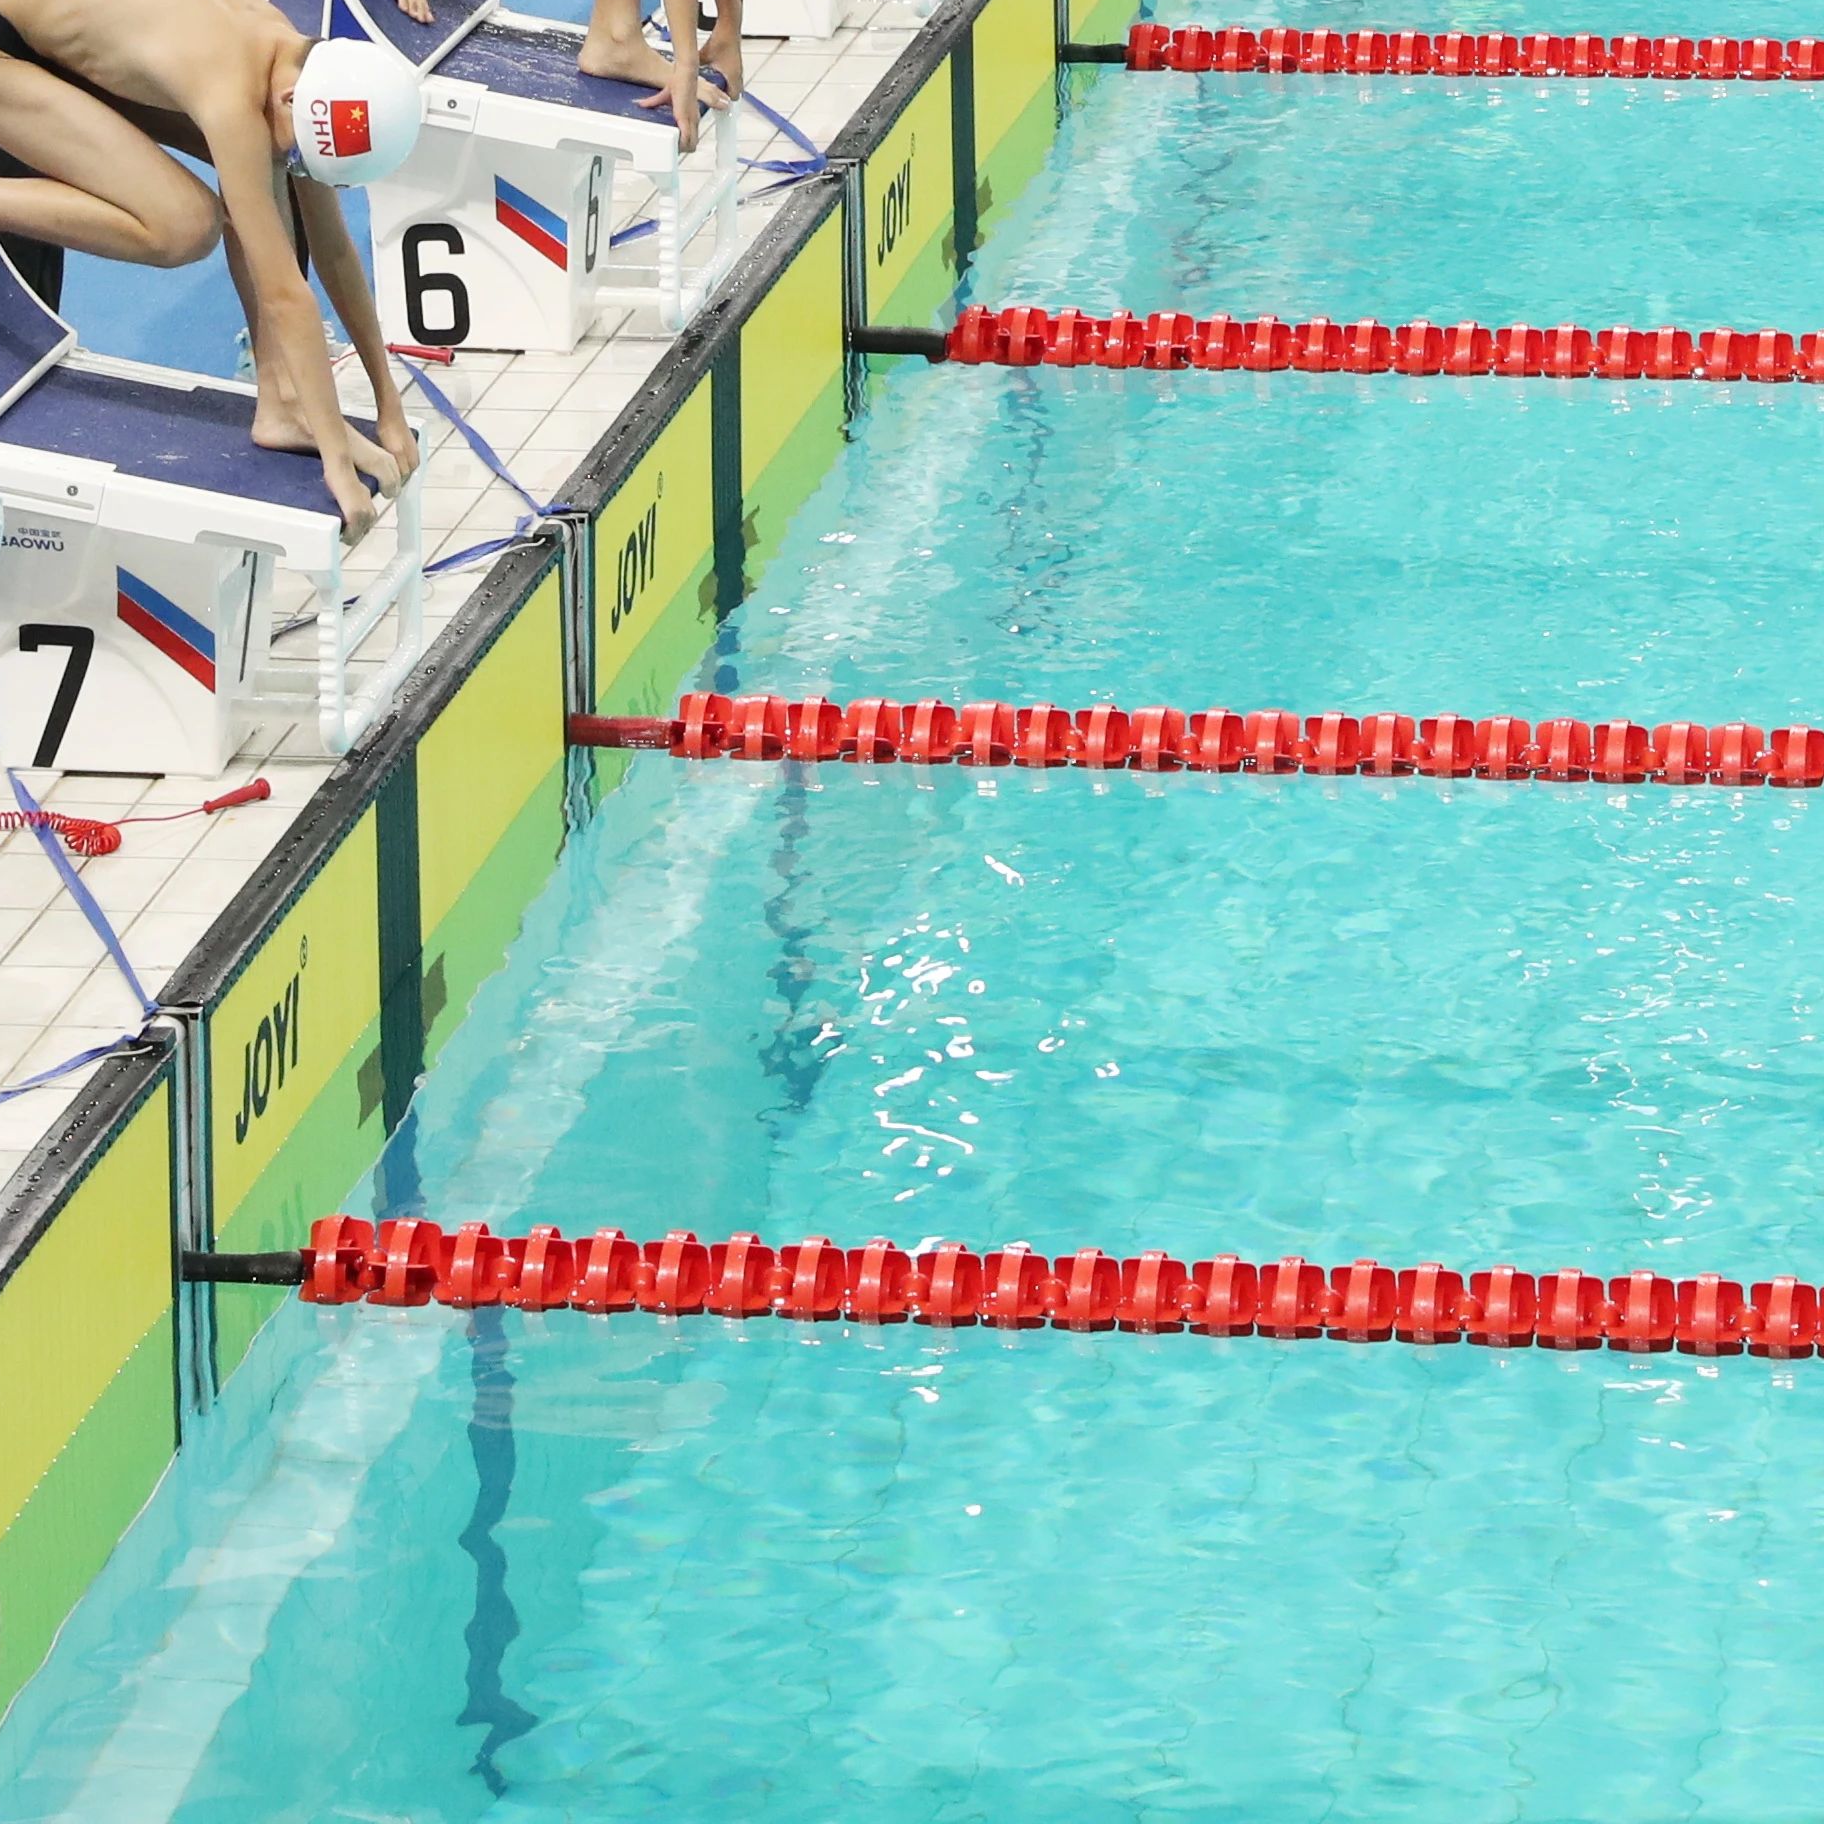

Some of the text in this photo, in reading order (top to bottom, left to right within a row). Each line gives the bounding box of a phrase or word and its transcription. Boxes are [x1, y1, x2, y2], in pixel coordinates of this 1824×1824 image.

[309, 98, 334, 158] CHN
[586, 155, 602, 274] 6
[878, 157, 911, 267] JOYI
[401, 222, 471, 346] 6
[611, 501, 657, 635] JOYI
[18, 623, 95, 768] 7
[235, 972, 300, 1145] JOYI
